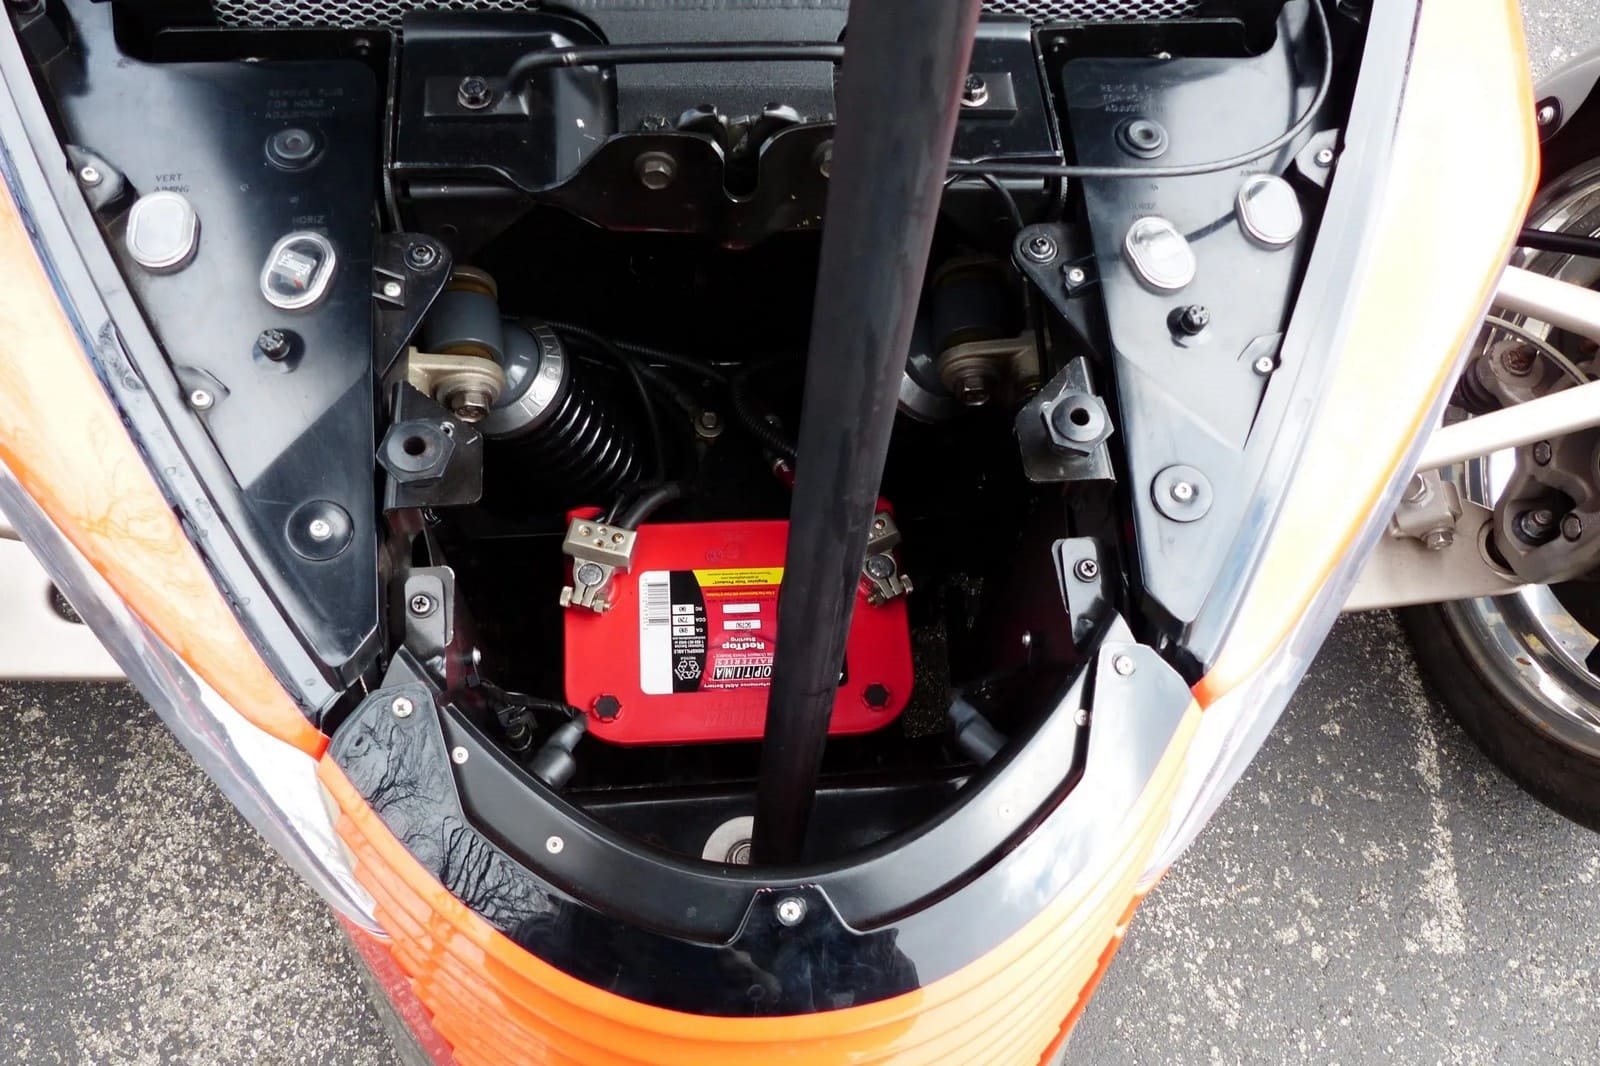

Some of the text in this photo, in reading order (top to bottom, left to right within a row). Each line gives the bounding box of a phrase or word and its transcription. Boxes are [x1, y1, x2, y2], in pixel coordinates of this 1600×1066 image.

[154, 173, 184, 183] VERT
[292, 215, 326, 225] HORIZ
[722, 641, 765, 651] RedTop
[716, 657, 773, 666] BATTERIES
[715, 666, 772, 680] OPTIMA
